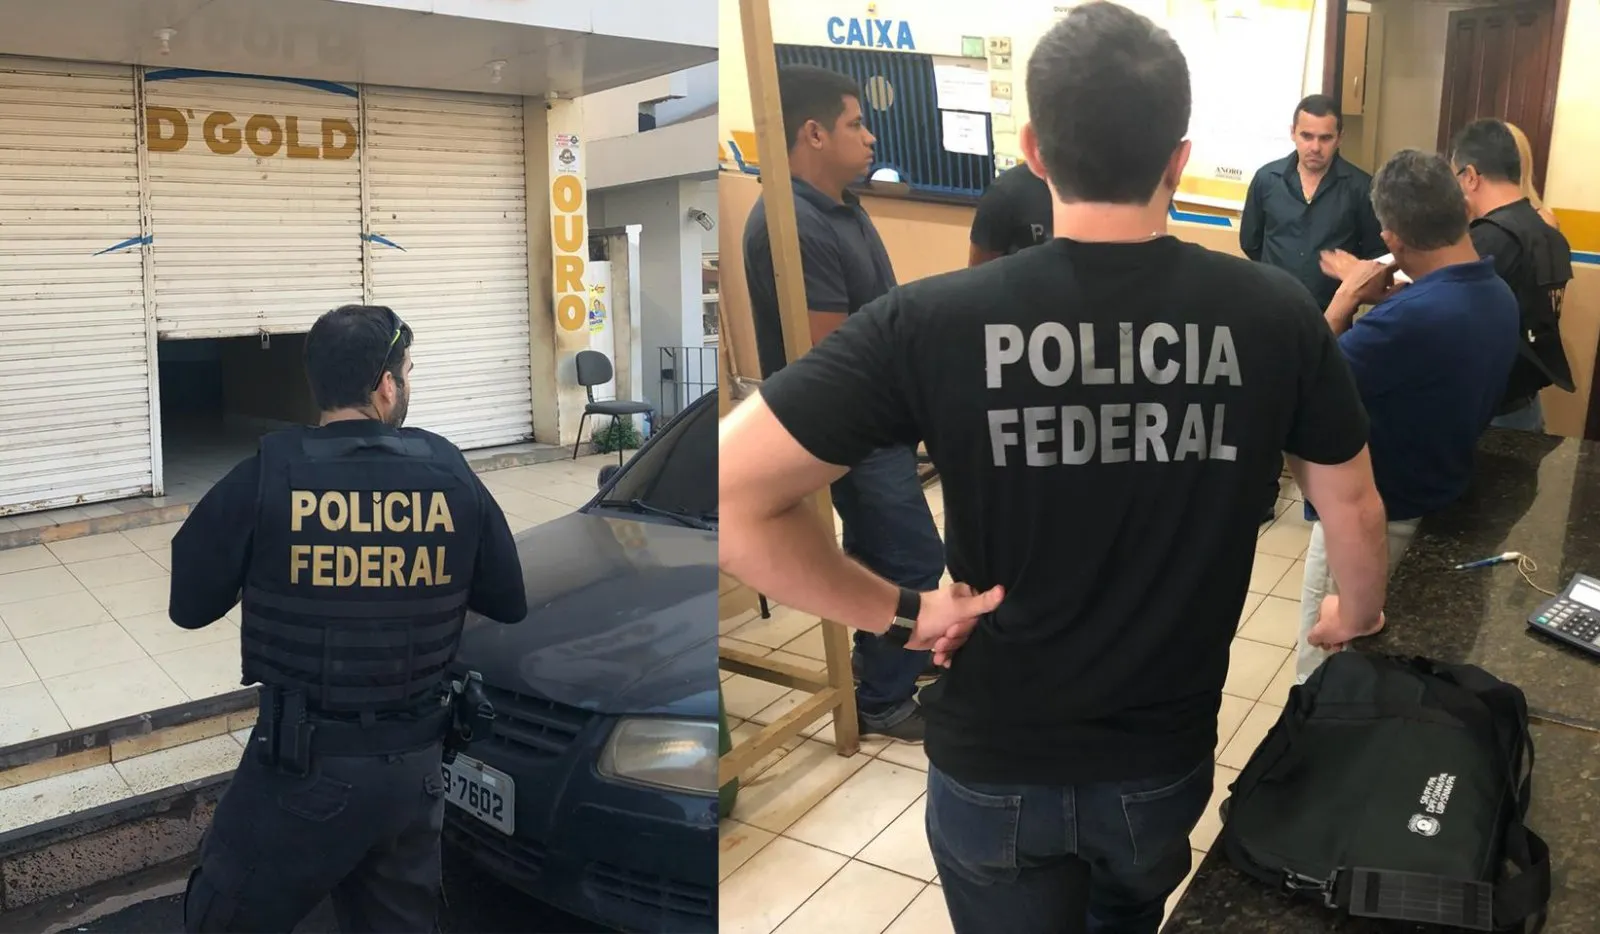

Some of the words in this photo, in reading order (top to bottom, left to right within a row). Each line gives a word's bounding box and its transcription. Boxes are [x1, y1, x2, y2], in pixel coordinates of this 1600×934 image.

[827, 16, 916, 50] CAIXA
[552, 174, 587, 331] OURO
[987, 402, 1238, 467] FEDERAL
[290, 545, 452, 587] FEDERAL
